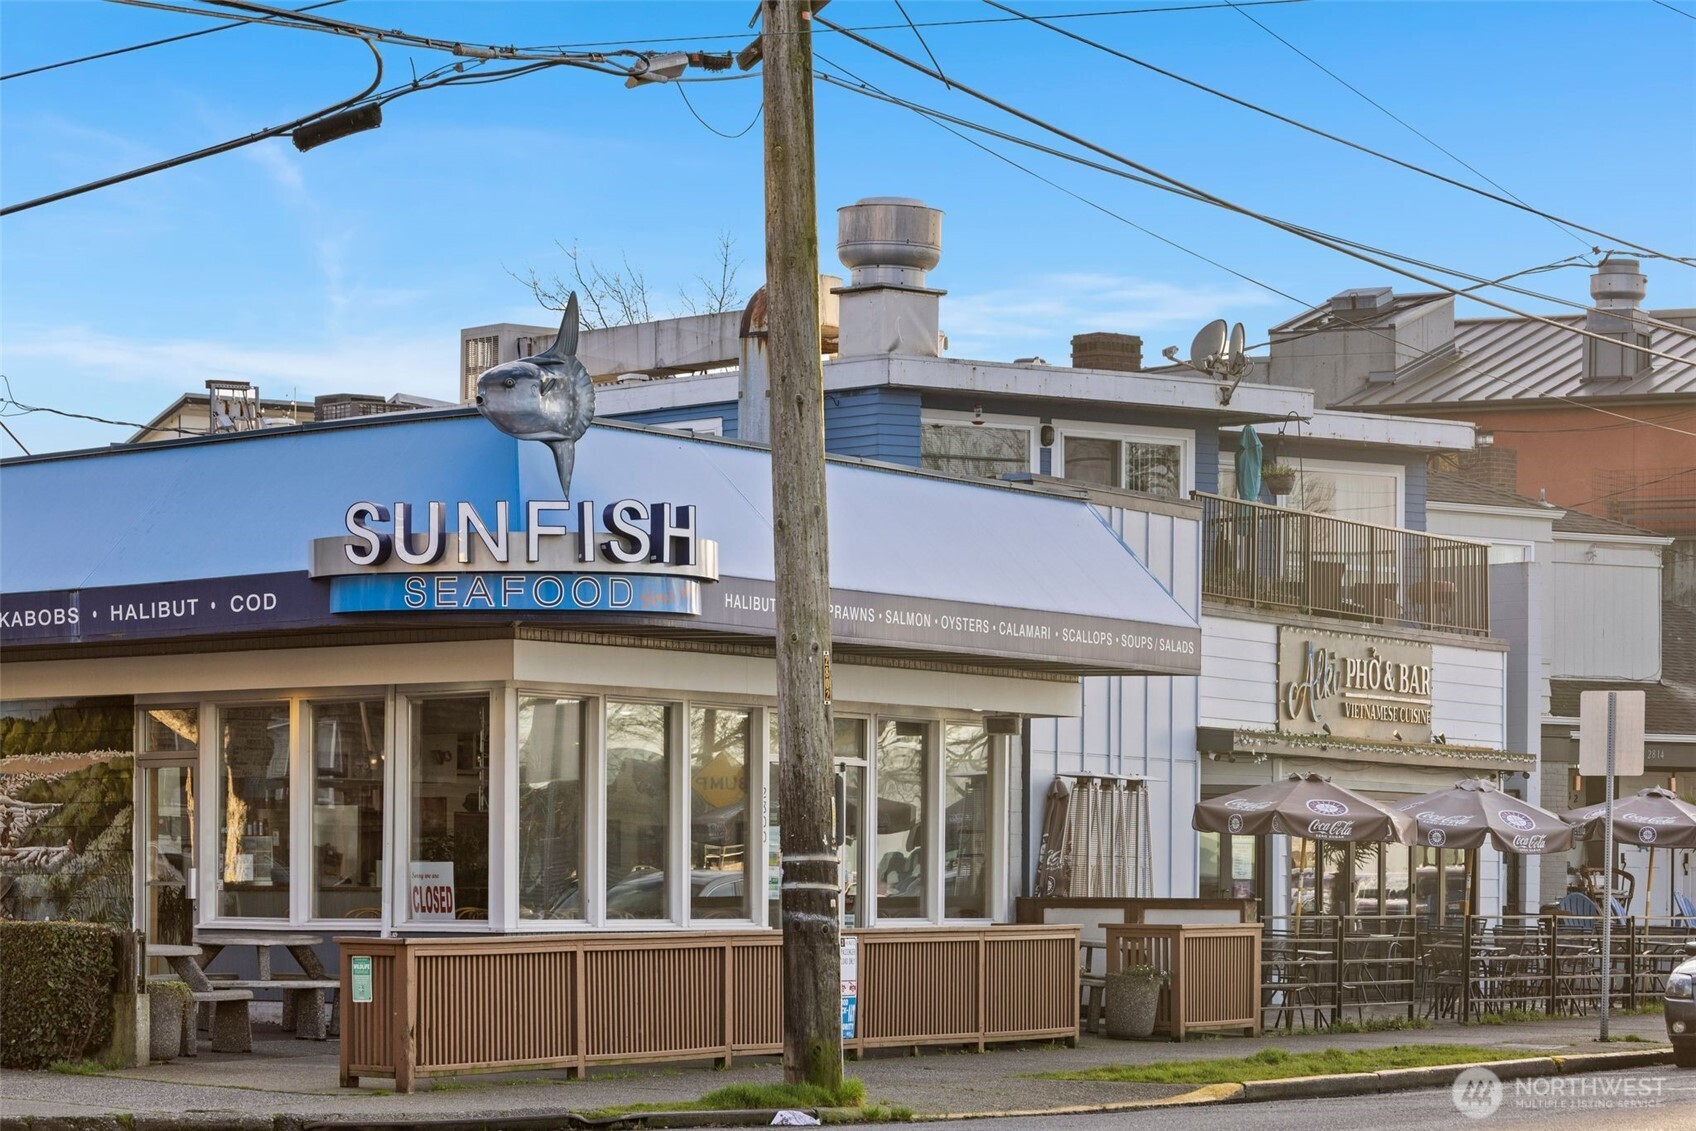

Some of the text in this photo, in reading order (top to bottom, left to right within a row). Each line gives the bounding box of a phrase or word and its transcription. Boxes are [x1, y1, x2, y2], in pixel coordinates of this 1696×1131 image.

[344, 498, 697, 566] SUNFISH
[404, 575, 634, 608] SEAFOOD
[0, 593, 277, 628] KABOBS HALIBUT COD
[725, 593, 776, 613] HALIBUT
[885, 609, 931, 628] SALMON
[940, 615, 990, 634] OYSTERS
[999, 621, 1051, 640] CALAMARI
[1062, 628, 1113, 646] SCALLOPS
[1288, 640, 1341, 722] Alki
[1384, 660, 1396, 692] &
[1399, 663, 1431, 696] BAR
[1345, 702, 1432, 725] VIETNAMESE CUISINE
[1647, 749, 1665, 760] 2814
[412, 885, 453, 914] CLOSED
